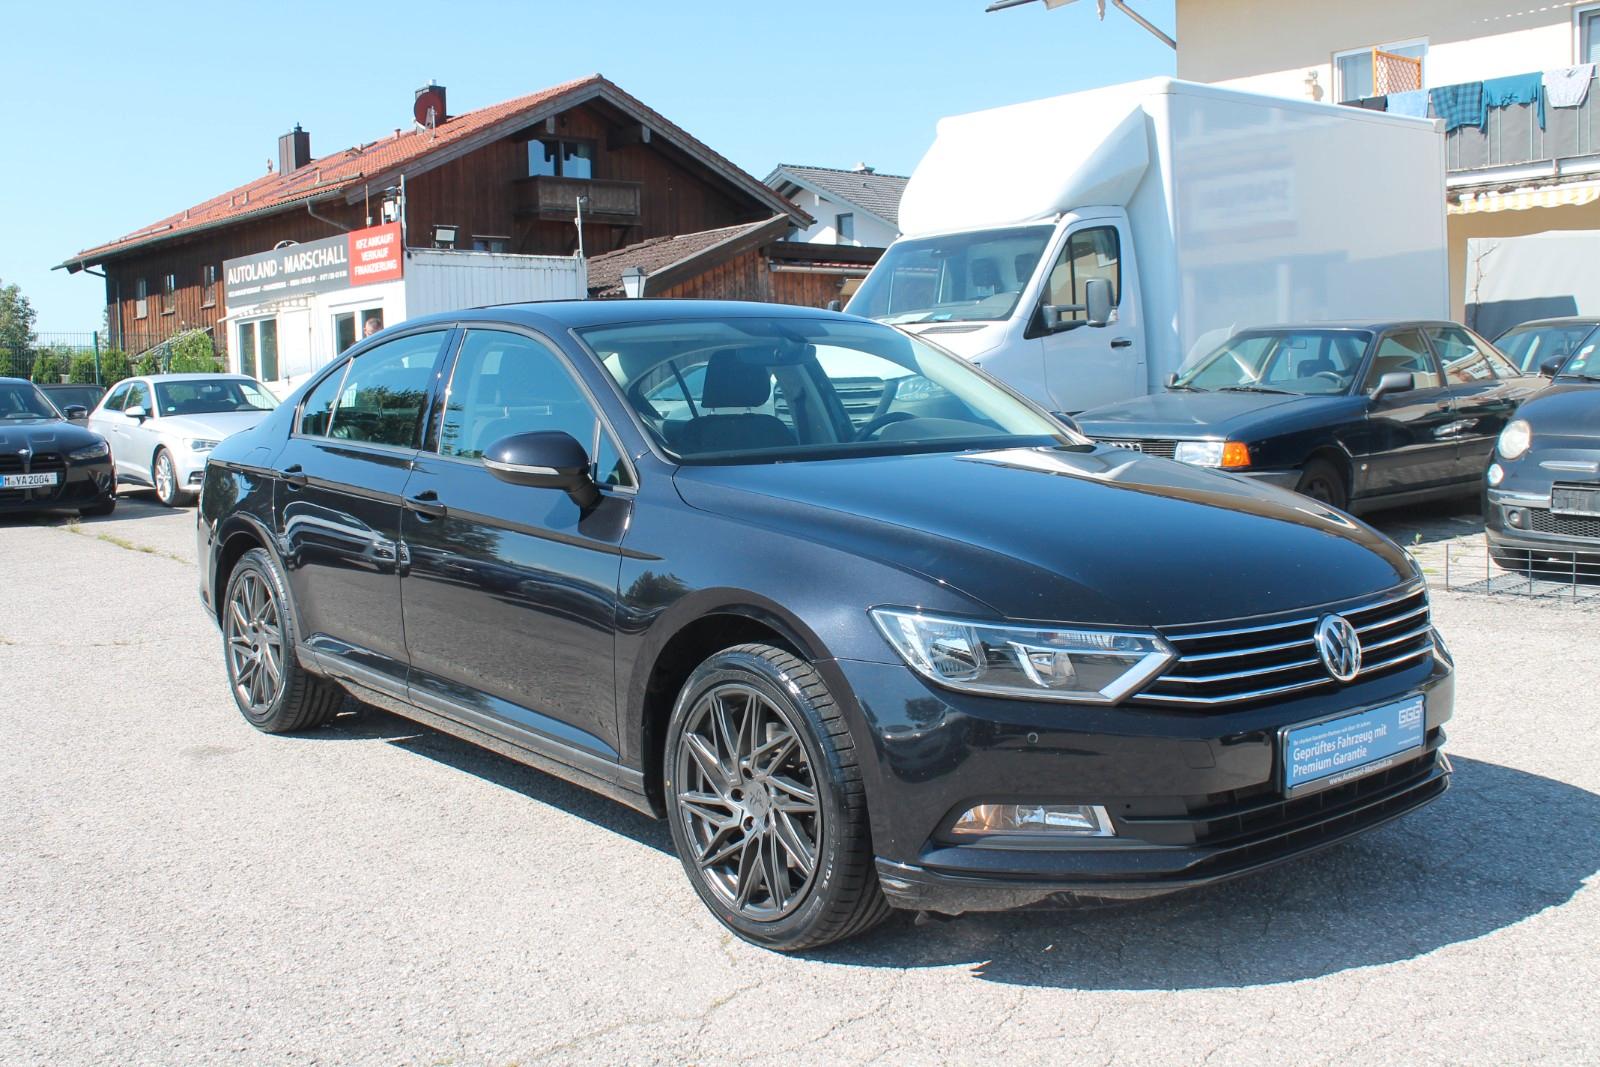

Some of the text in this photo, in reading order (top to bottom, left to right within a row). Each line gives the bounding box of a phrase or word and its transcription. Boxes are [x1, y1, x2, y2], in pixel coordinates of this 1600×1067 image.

[228, 261, 277, 285] AUTOLAND
[284, 245, 347, 274] MARSCHALL
[355, 260, 397, 275] FINANZIERUNG
[361, 248, 388, 261] VERKAUF
[1293, 741, 1336, 762] Geprüftes
[1337, 730, 1373, 750] Fahrzeug
[1374, 724, 1387, 740] mit
[1293, 746, 1367, 777] Premium Garantie
